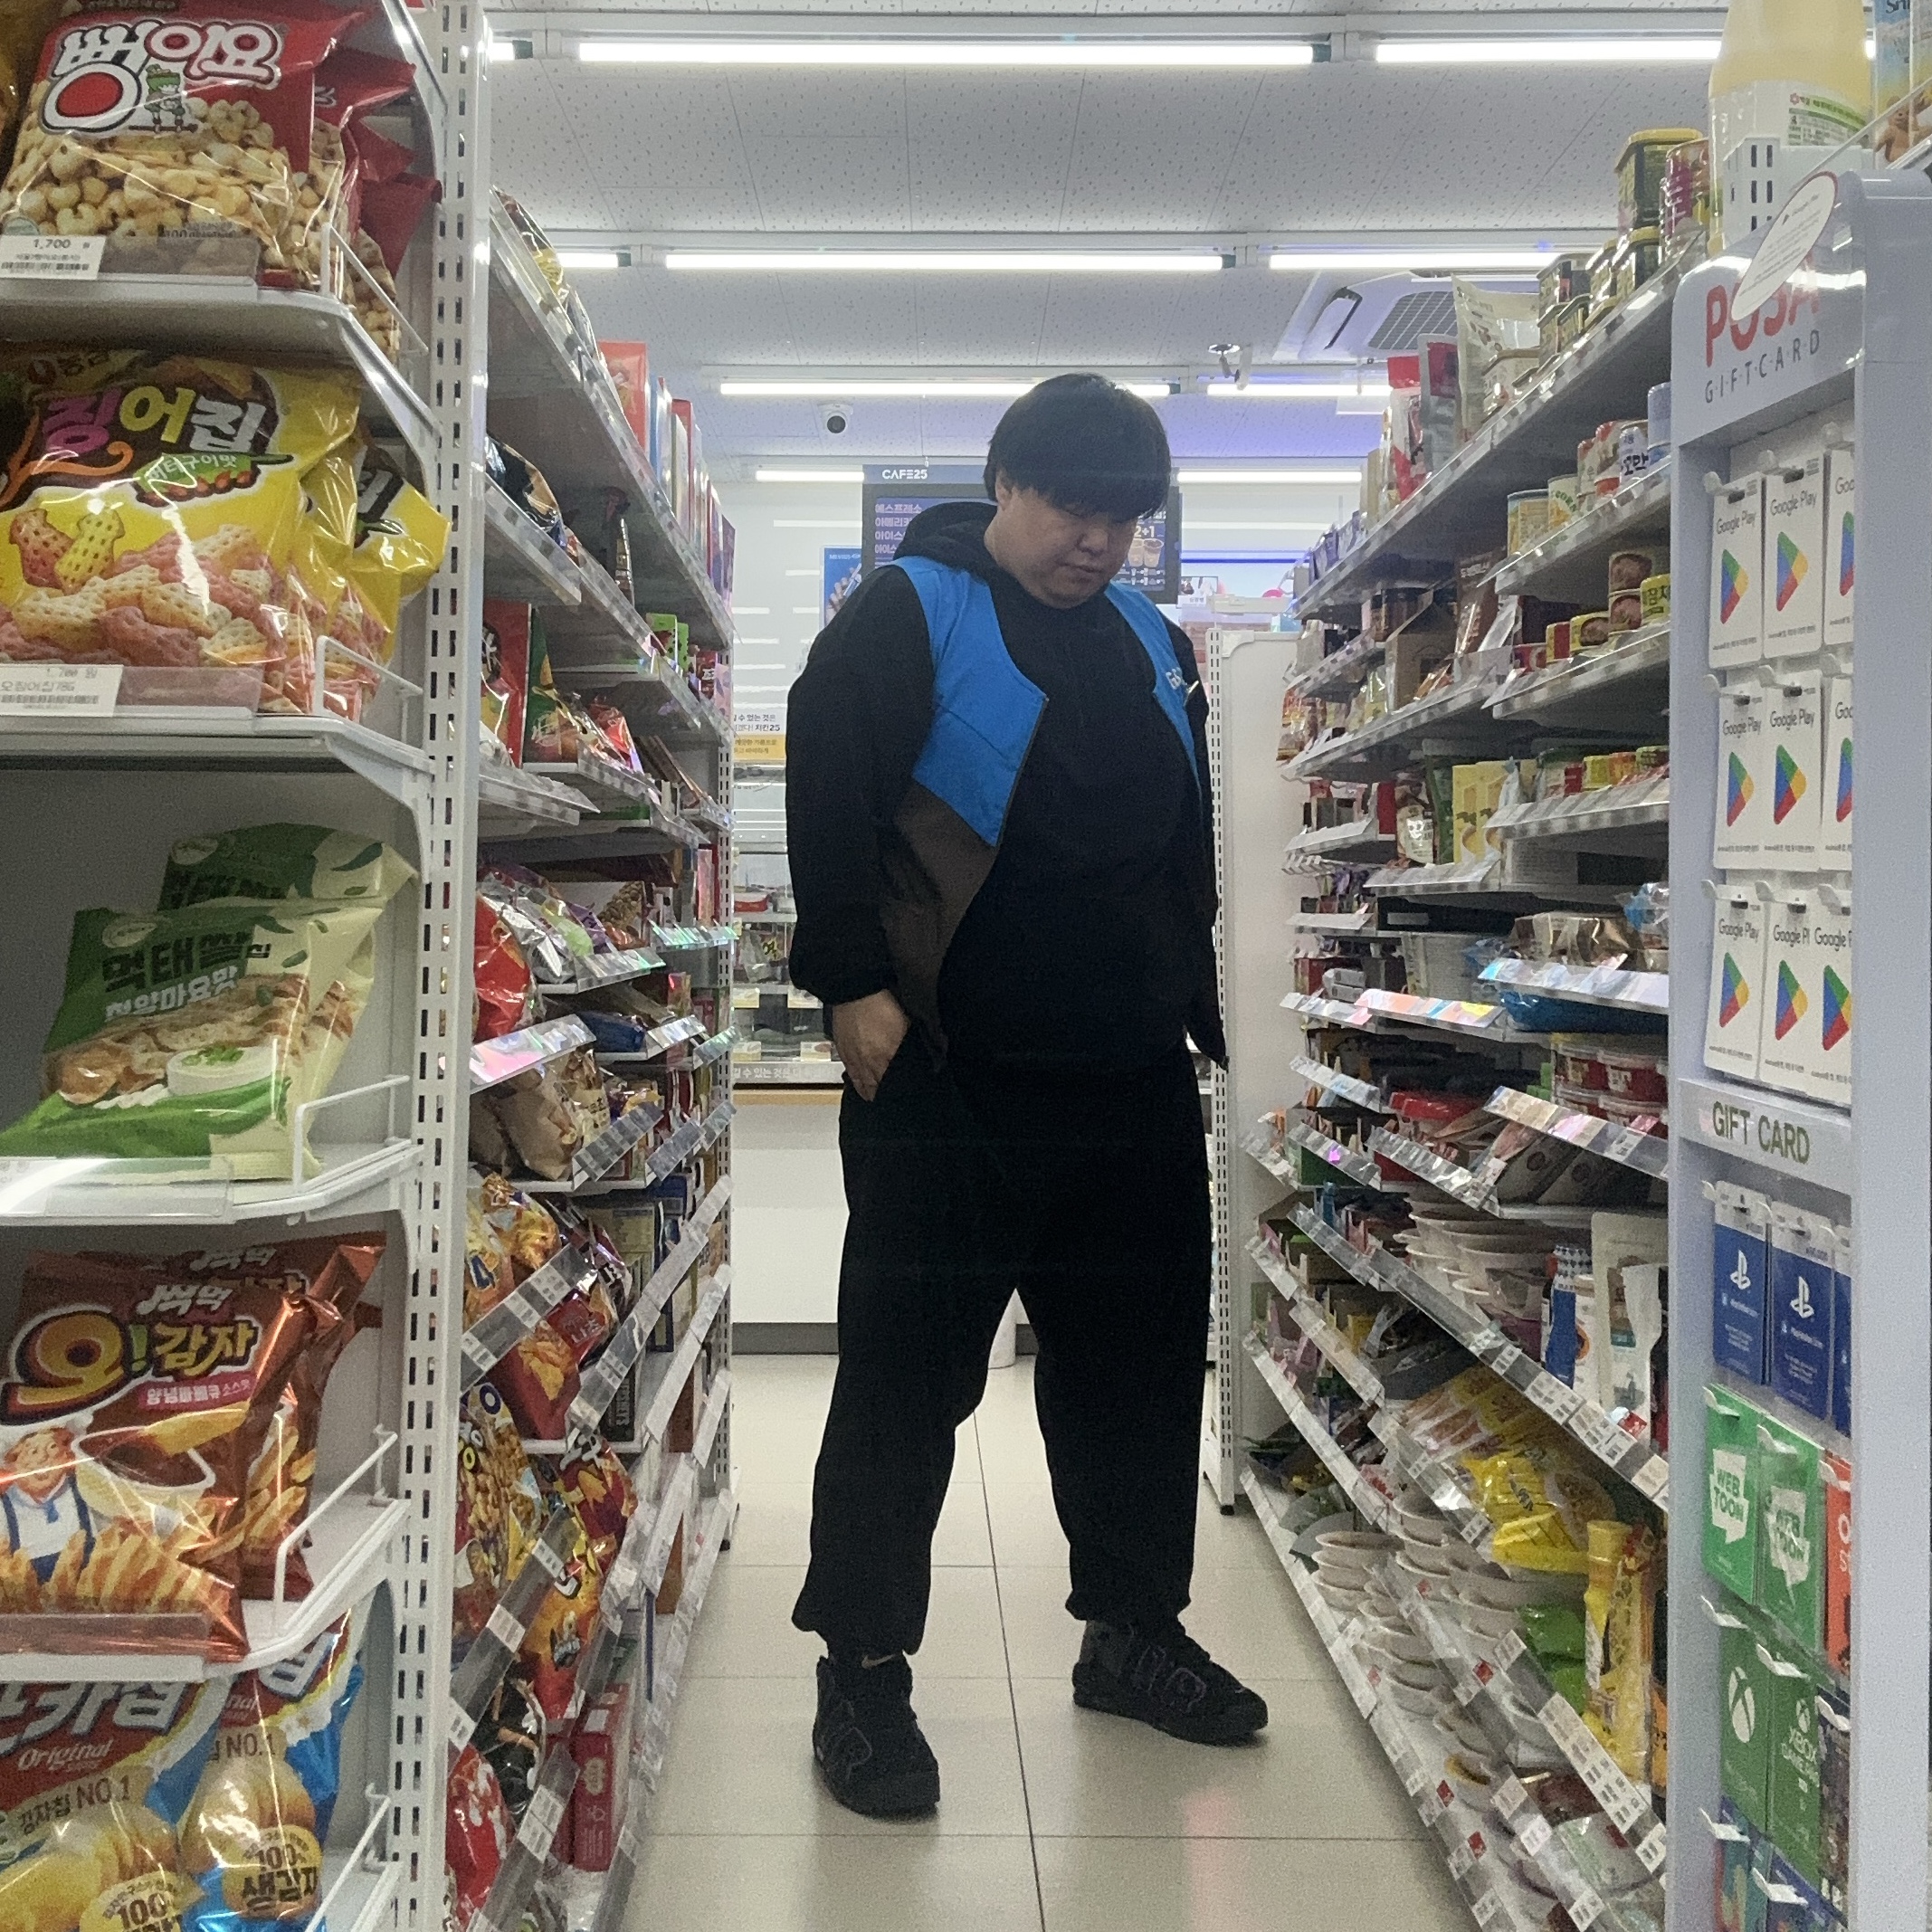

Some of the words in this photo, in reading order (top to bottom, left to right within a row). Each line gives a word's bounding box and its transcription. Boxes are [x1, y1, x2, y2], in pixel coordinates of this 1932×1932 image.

[41, 18, 282, 136] 뻥이요
[33, 238, 71, 250] 1,700
[881, 469, 928, 480] CAFE25
[1835, 477, 1855, 495] Goo
[874, 503, 923, 514] 에스프레소
[1770, 495, 1799, 517] Google
[1800, 490, 1817, 509] Play
[874, 517, 912, 528] 아메리카
[1134, 525, 1156, 538] 2+1
[1717, 513, 1740, 534] Google
[1741, 509, 1757, 528] Play
[738, 714, 746, 722] 수
[1770, 710, 1797, 731] Google
[1798, 708, 1816, 728] Play
[1835, 700, 1853, 719] Goo
[1722, 719, 1746, 738] Google
[1747, 716, 1762, 735] Play
[1718, 918, 1743, 941] Google
[1745, 921, 1759, 943] Play
[1773, 924, 1801, 947] Google
[1814, 927, 1847, 952] Google
[743, 1068, 752, 1079] 수
[753, 1068, 772, 1079] 있는
[1712, 1100, 1751, 1146] GIFT
[1757, 1114, 1811, 1165] CARD
[137, 1284, 234, 1316] 찍먹
[7, 1309, 260, 1414] 오!감자
[1717, 1469, 1741, 1498] WEB
[1713, 1486, 1745, 1524] TOON
[17, 1737, 114, 1772] Original
[17, 1793, 71, 1836] 감자칩
